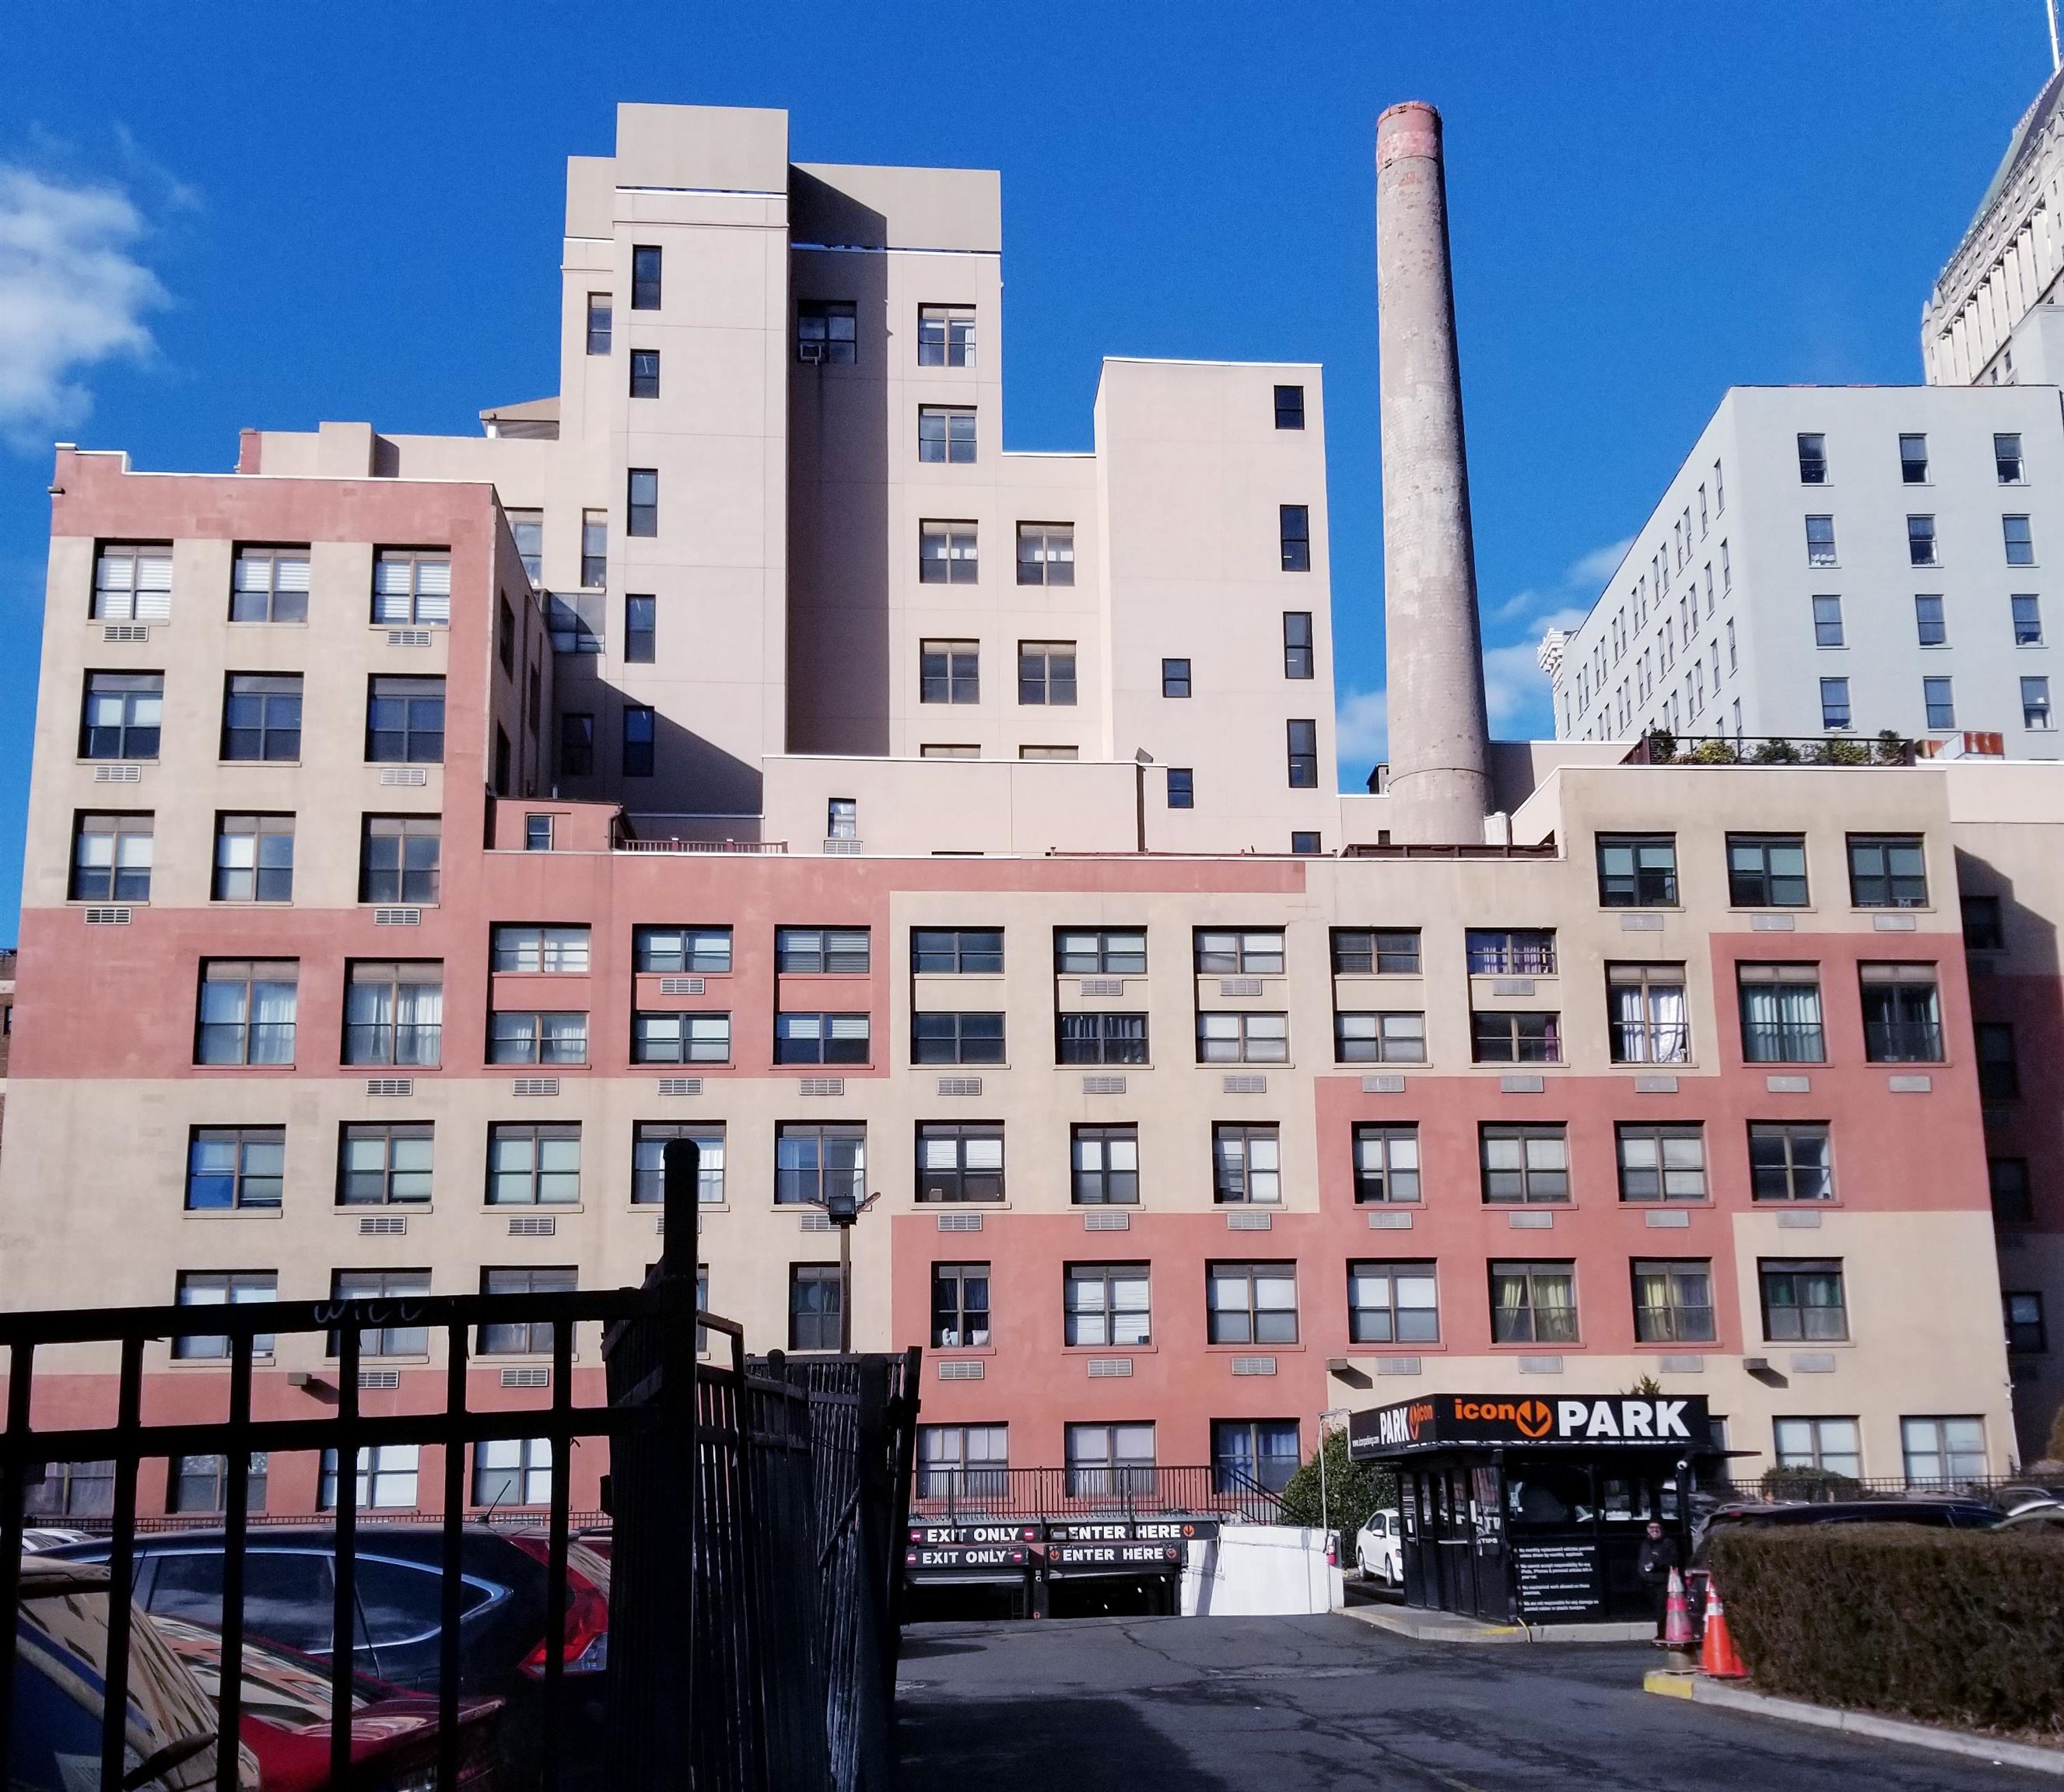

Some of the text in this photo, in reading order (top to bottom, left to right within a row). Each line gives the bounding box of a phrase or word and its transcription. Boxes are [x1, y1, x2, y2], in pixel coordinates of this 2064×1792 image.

[1455, 1398, 1691, 1437] icon PARK
[1379, 1406, 1410, 1444] PARK
[927, 1528, 1019, 1542] EXIT ONLY
[1067, 1524, 1181, 1539] ENTER HERE
[922, 1550, 1006, 1564] EXIT ONLY
[1063, 1549, 1164, 1561] ENTER HERE
